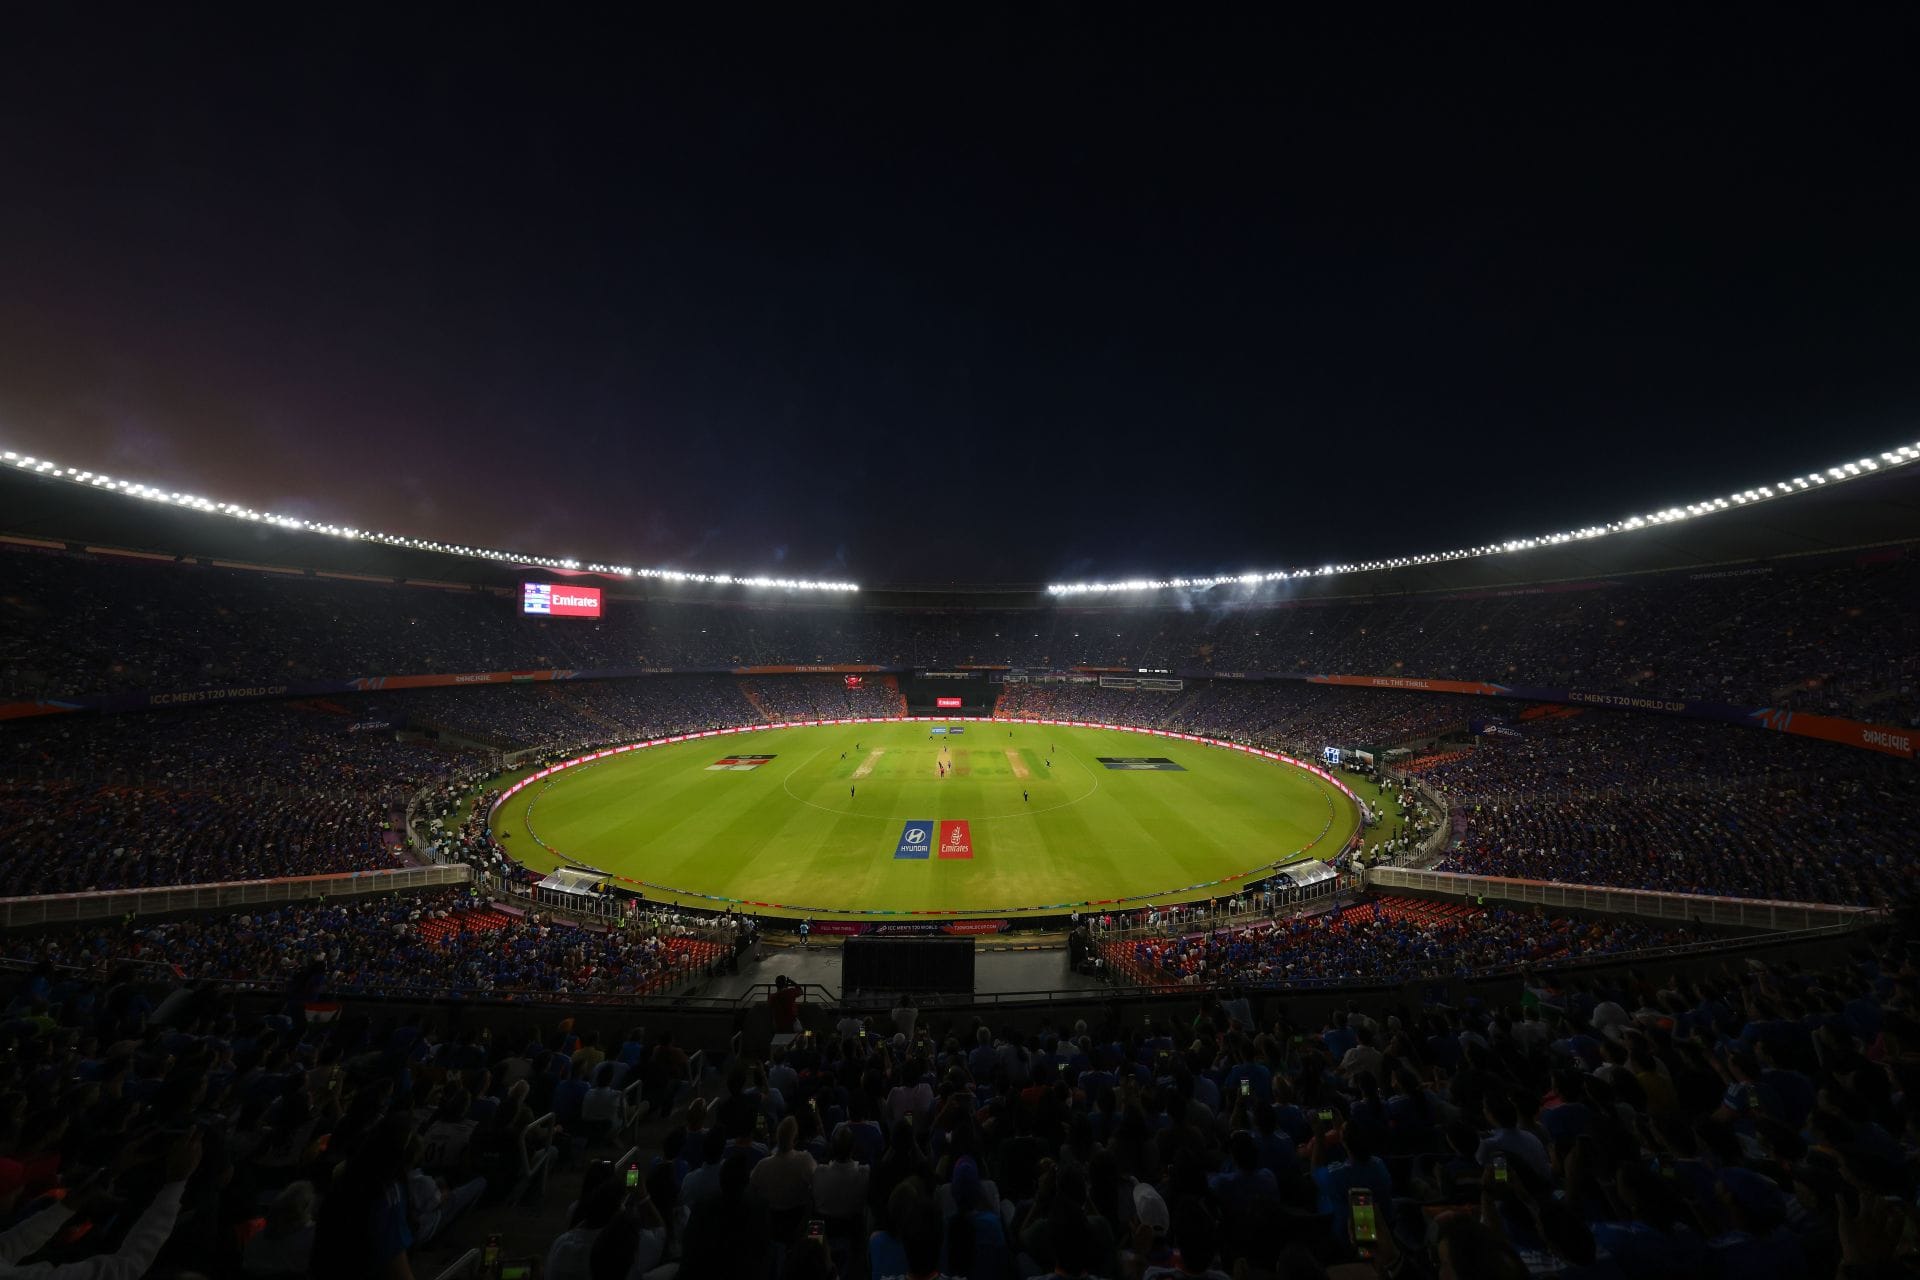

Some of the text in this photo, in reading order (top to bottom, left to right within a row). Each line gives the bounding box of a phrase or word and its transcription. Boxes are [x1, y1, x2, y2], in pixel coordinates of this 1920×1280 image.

[552, 594, 598, 607] Emirates
[150, 685, 287, 704] ICC MEN'S T20 WORLD CUP
[1568, 691, 1686, 712] ICC MEN'S T20 WORLD CUP
[941, 843, 969, 853] Emirates
